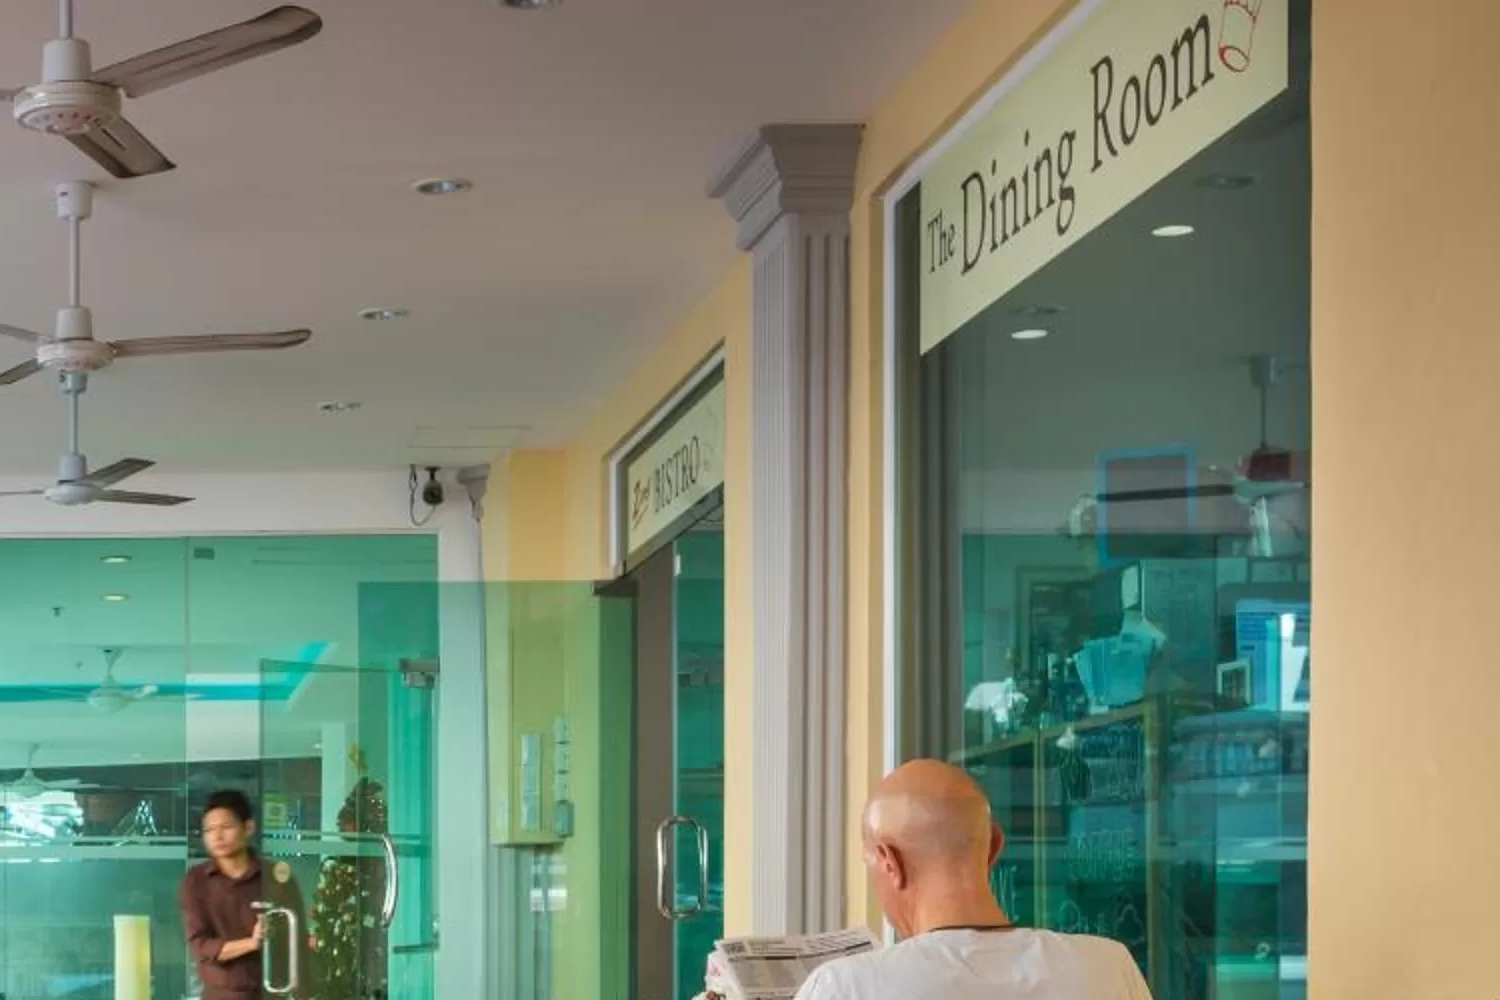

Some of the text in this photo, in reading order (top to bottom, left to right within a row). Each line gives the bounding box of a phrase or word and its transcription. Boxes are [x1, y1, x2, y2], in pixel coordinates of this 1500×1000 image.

[927, 14, 1215, 276] The Dining Room
[654, 435, 700, 513] BISTRO
